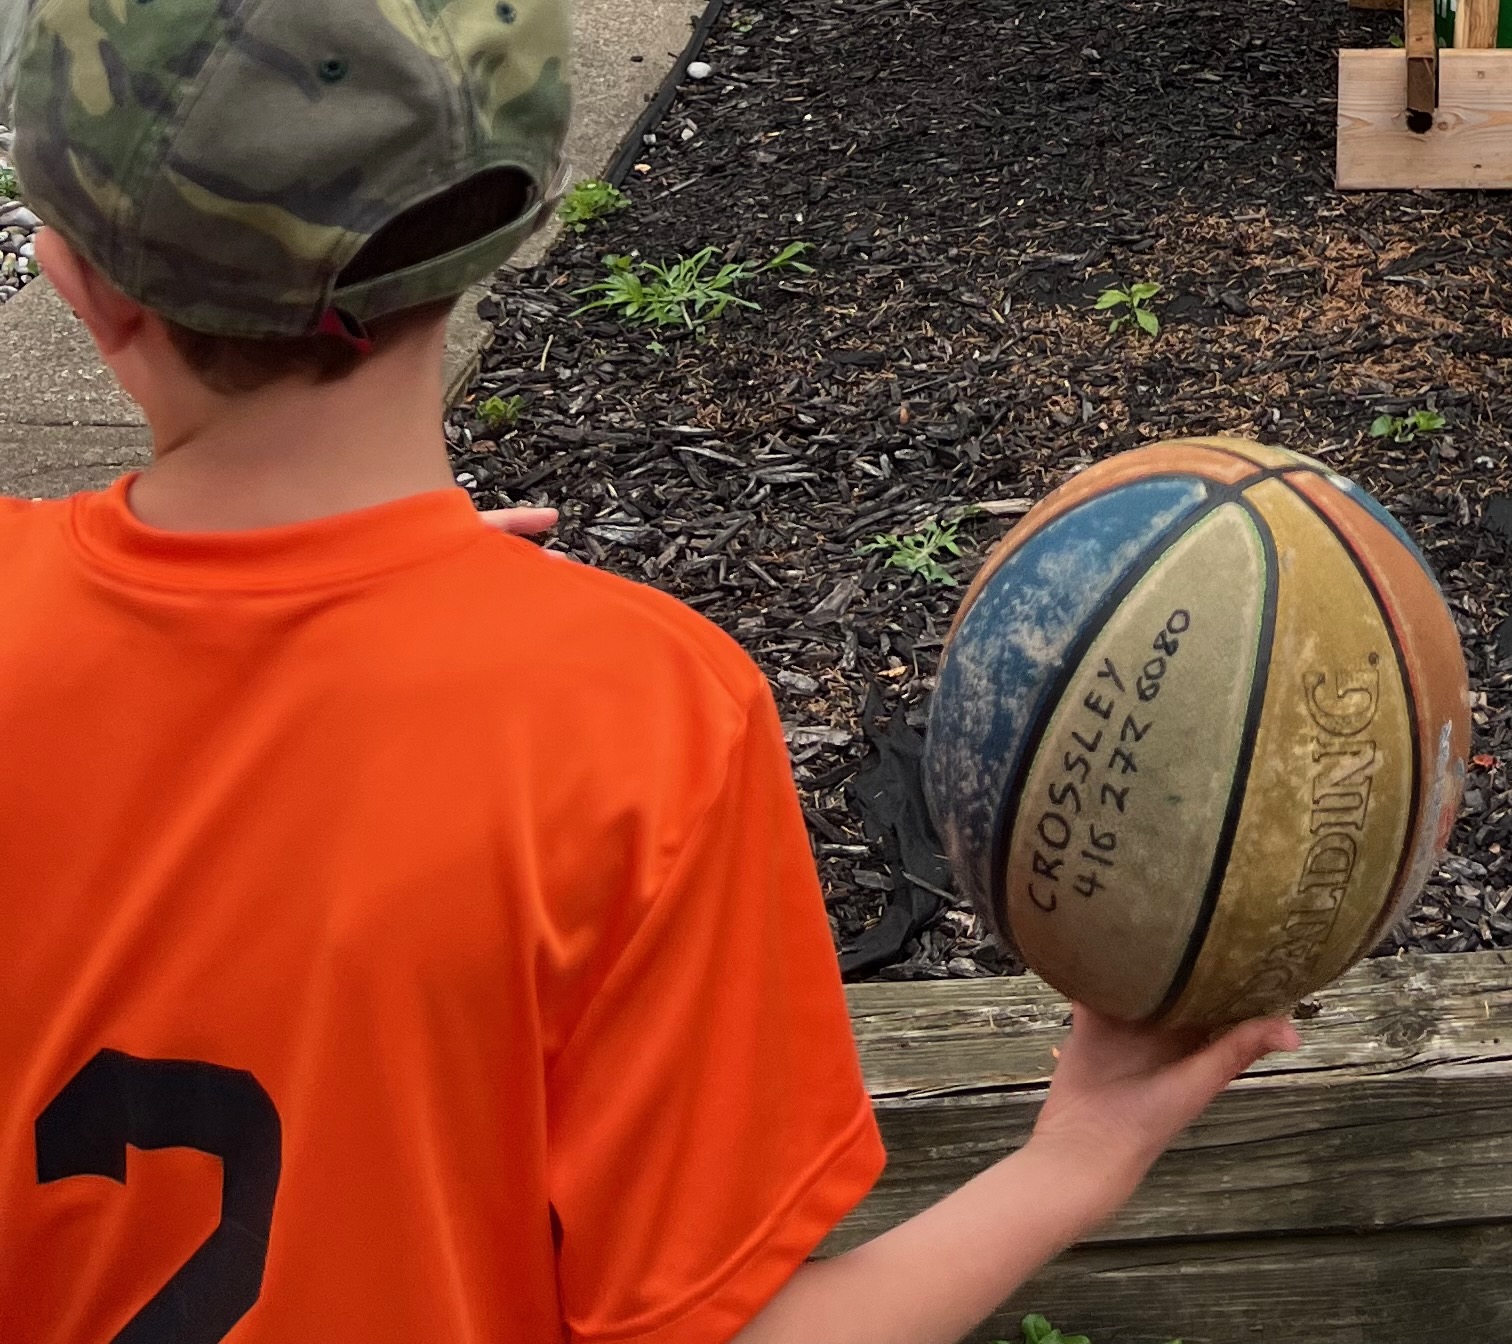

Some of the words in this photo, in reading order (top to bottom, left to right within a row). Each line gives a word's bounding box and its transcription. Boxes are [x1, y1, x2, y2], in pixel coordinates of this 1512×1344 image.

[1028, 657, 1125, 913] CROSSLEY
[1072, 823, 1117, 898] 416
[1136, 608, 1191, 703] 6080
